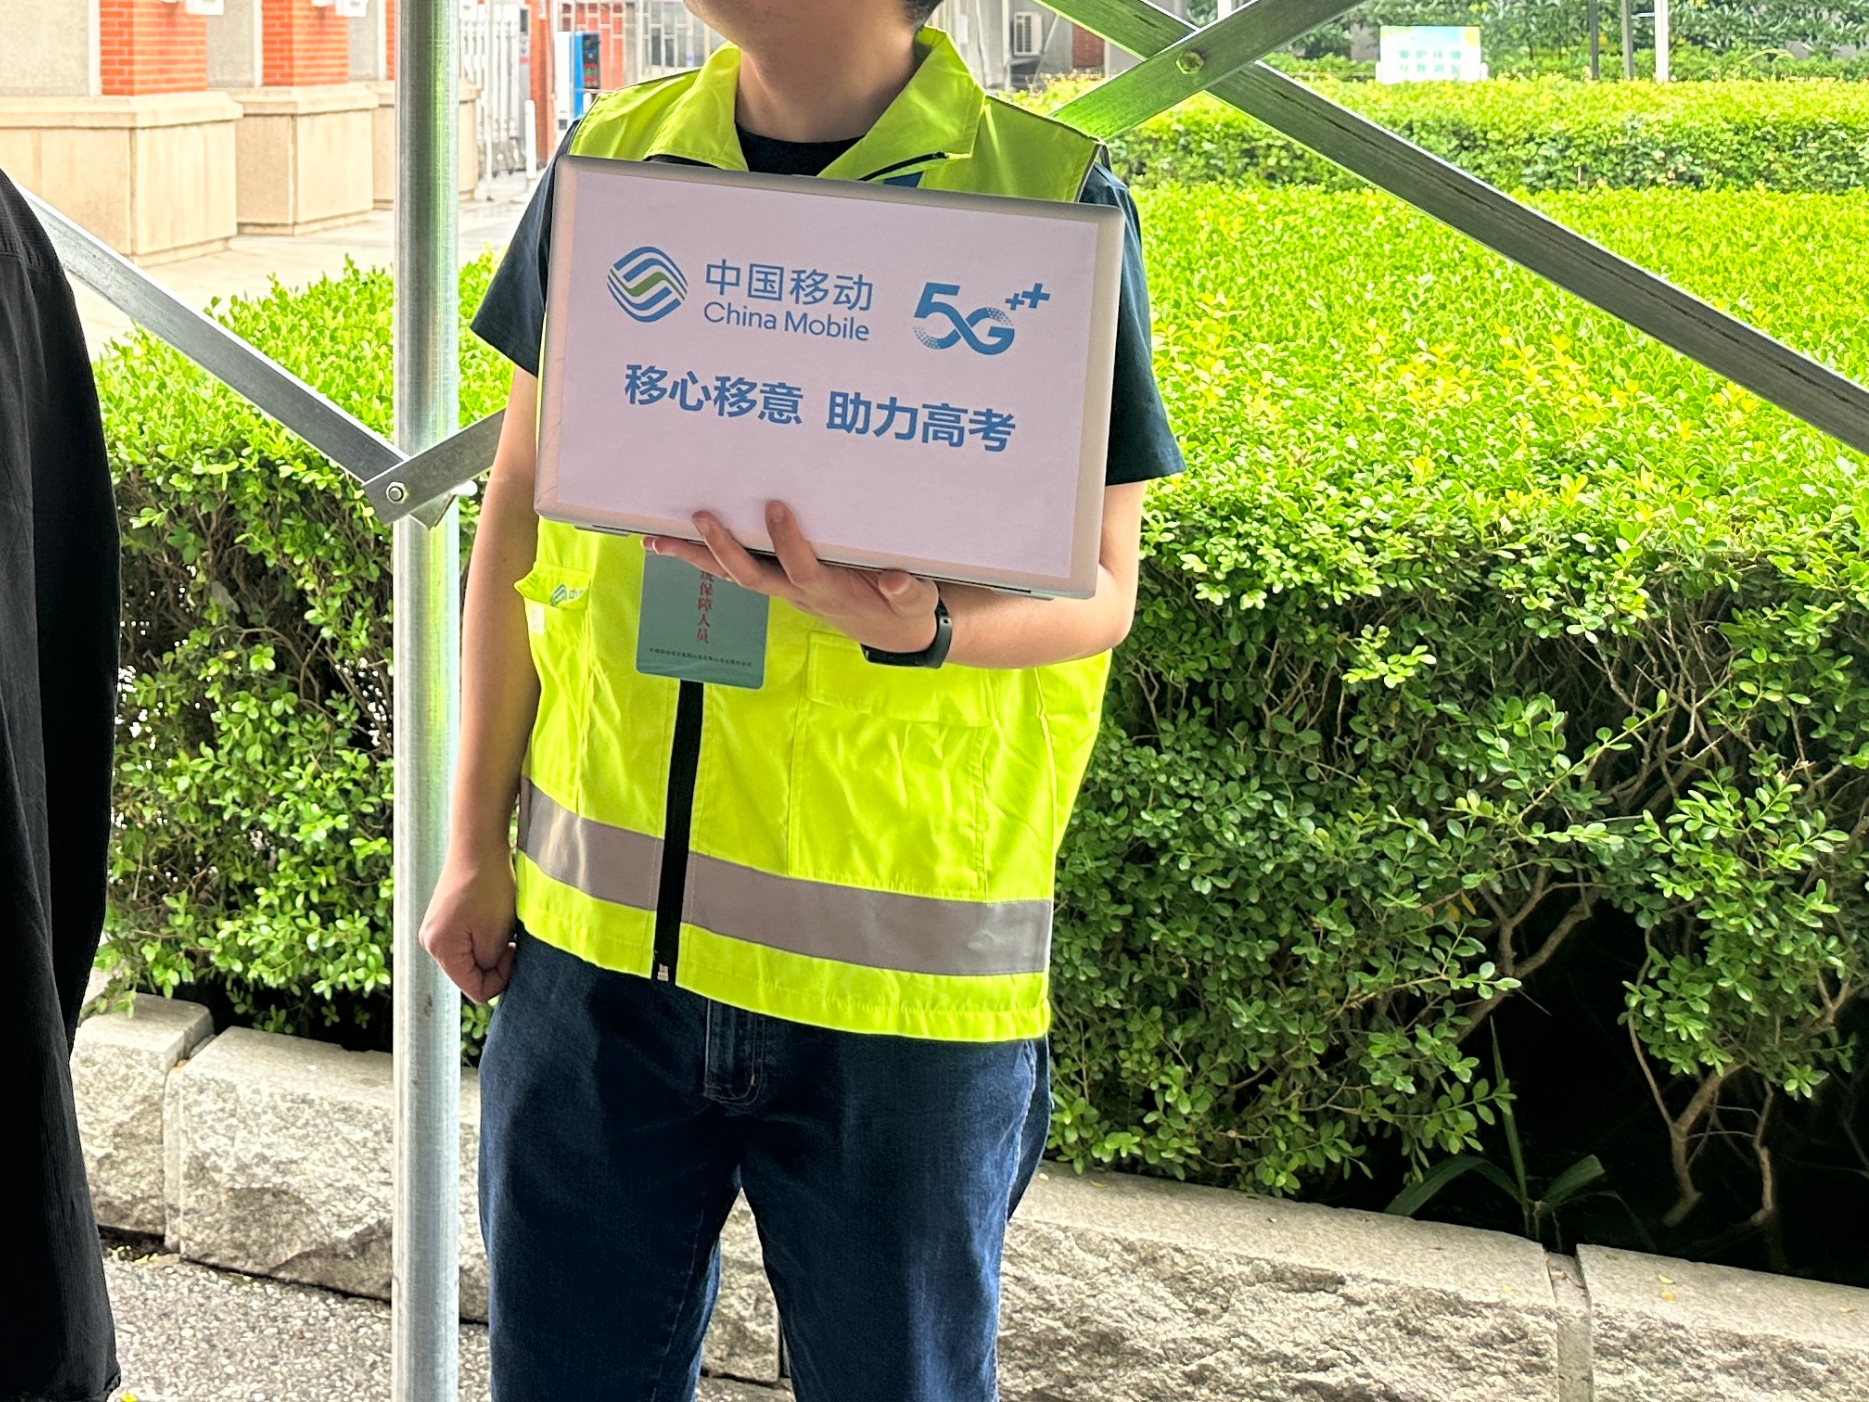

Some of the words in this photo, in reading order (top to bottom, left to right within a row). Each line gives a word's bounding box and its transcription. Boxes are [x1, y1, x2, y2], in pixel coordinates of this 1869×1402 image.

[704, 259, 874, 313] 中国移动
[703, 301, 778, 332] China
[784, 312, 871, 342] Mobile
[624, 364, 804, 426] 移心移意
[826, 391, 1017, 454] 助力高考
